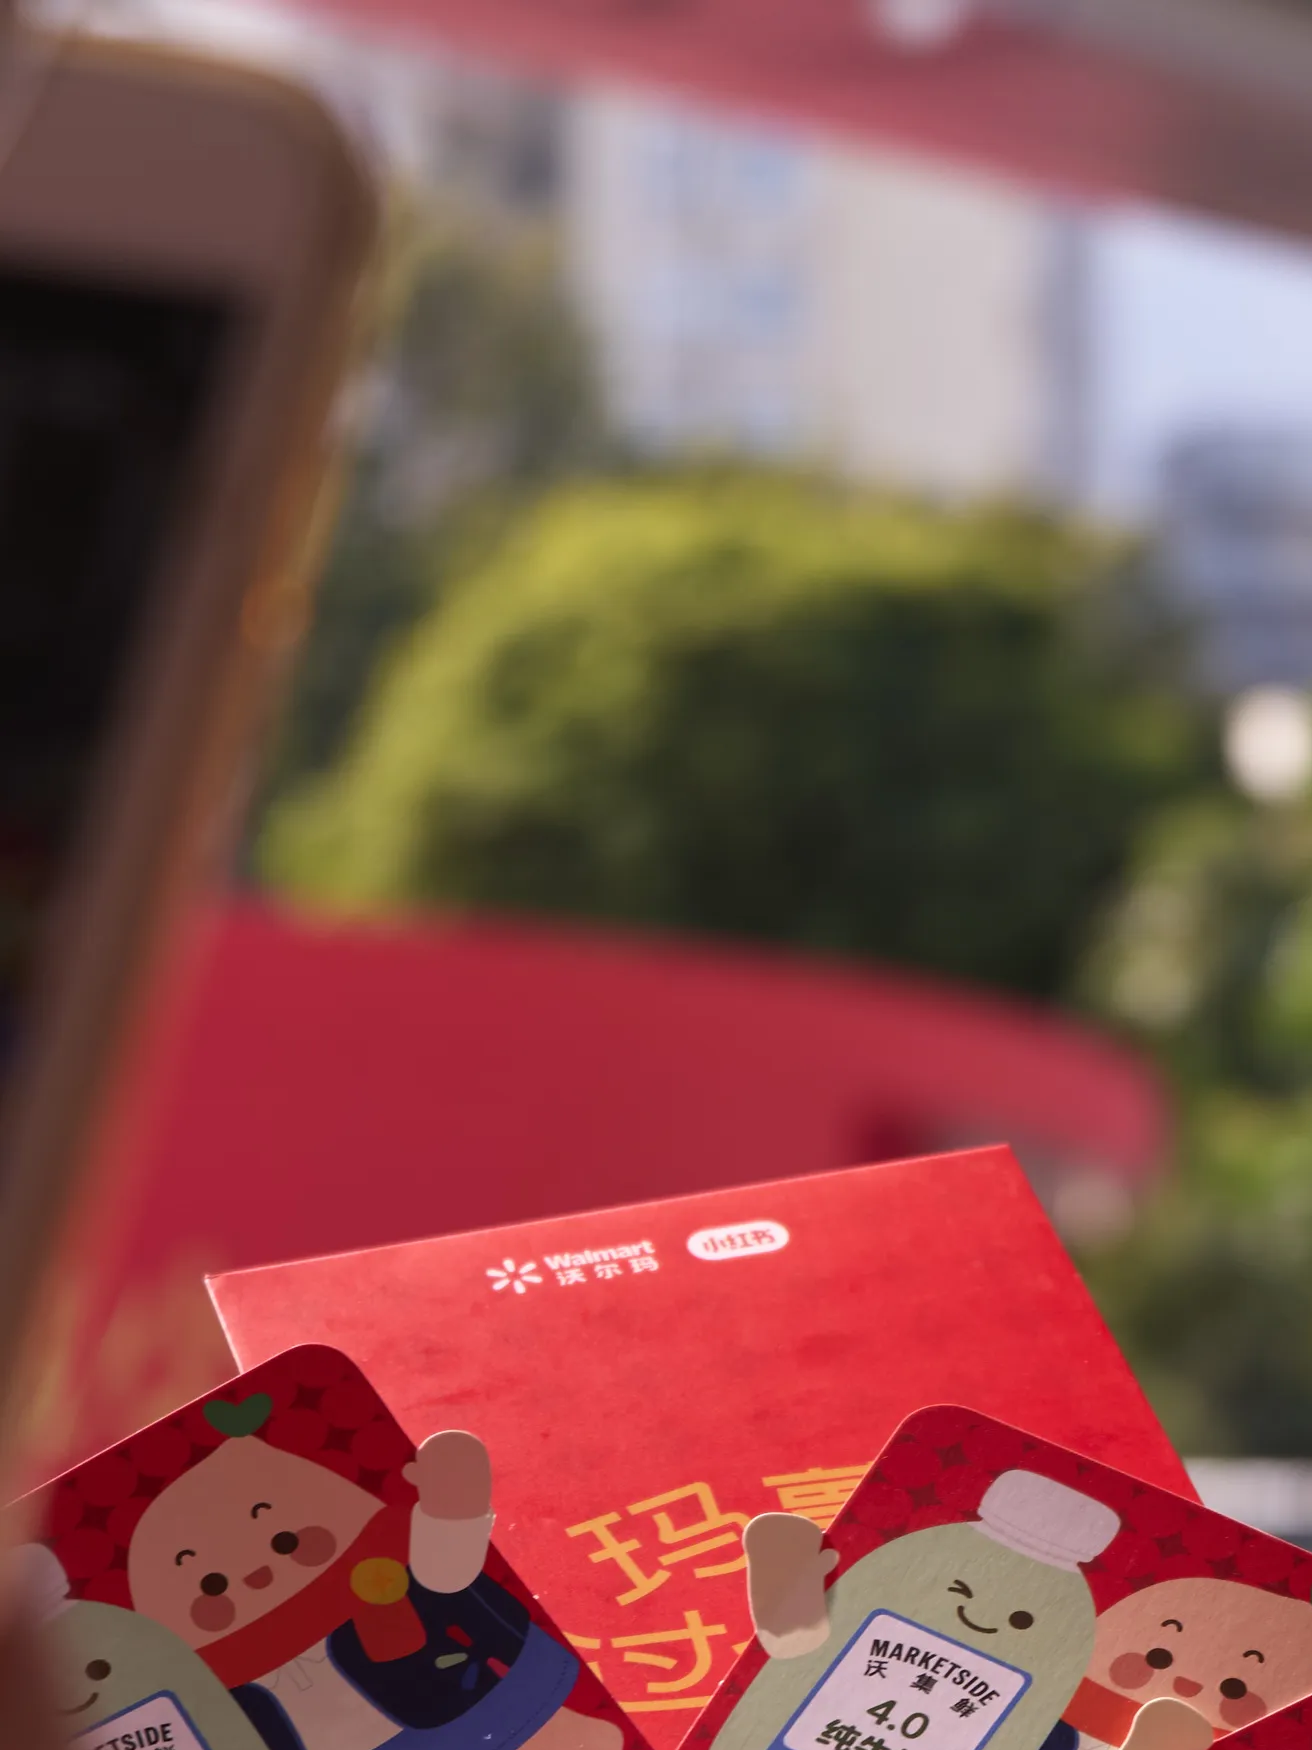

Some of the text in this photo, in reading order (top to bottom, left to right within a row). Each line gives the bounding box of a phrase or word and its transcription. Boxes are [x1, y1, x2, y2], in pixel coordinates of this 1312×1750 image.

[544, 1240, 655, 1270] Walmart
[702, 1228, 775, 1253] 小红书
[557, 1256, 659, 1286] 沃尔玛
[863, 1659, 979, 1719] 沃集鲜
[869, 1638, 1001, 1707] MARKETSIDE
[866, 1700, 930, 1739] 4.0
